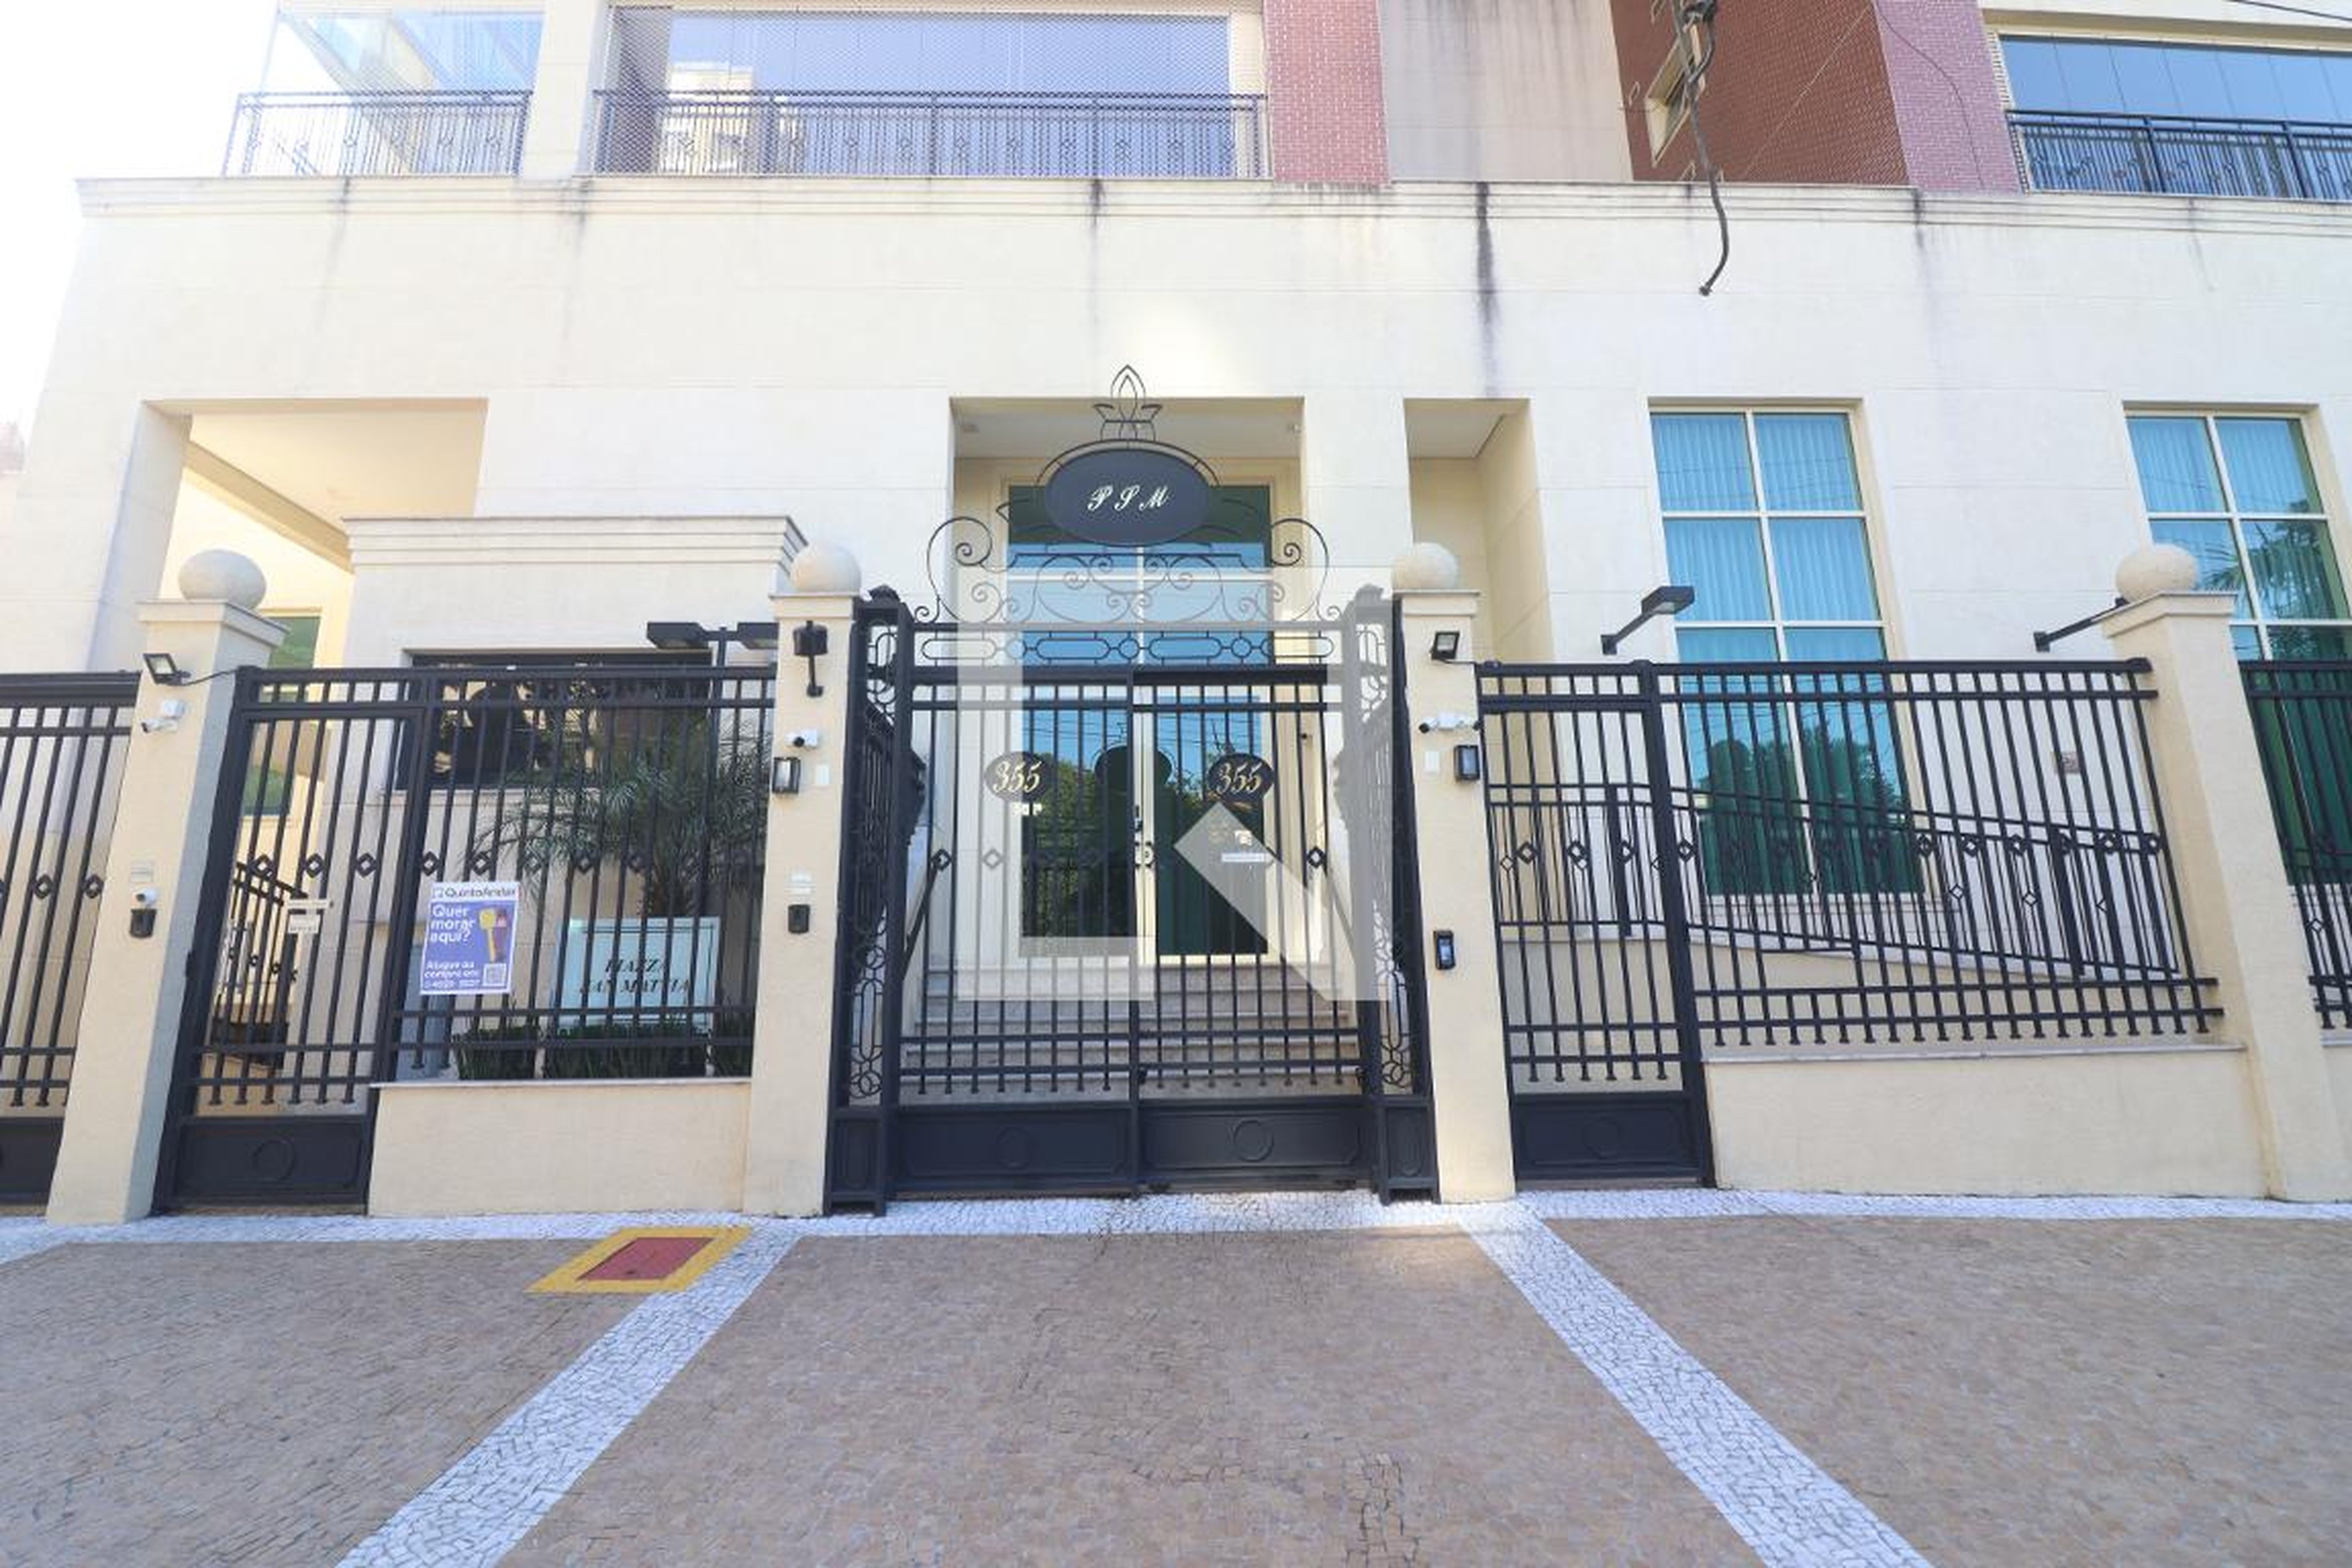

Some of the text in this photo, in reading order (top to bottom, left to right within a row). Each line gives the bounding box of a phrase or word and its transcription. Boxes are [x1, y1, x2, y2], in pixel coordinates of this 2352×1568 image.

[992, 760, 1042, 793] 355
[1216, 761, 1262, 795] 355
[432, 904, 469, 918] Quer
[430, 919, 475, 930] morar
[430, 929, 472, 946] aqui?
